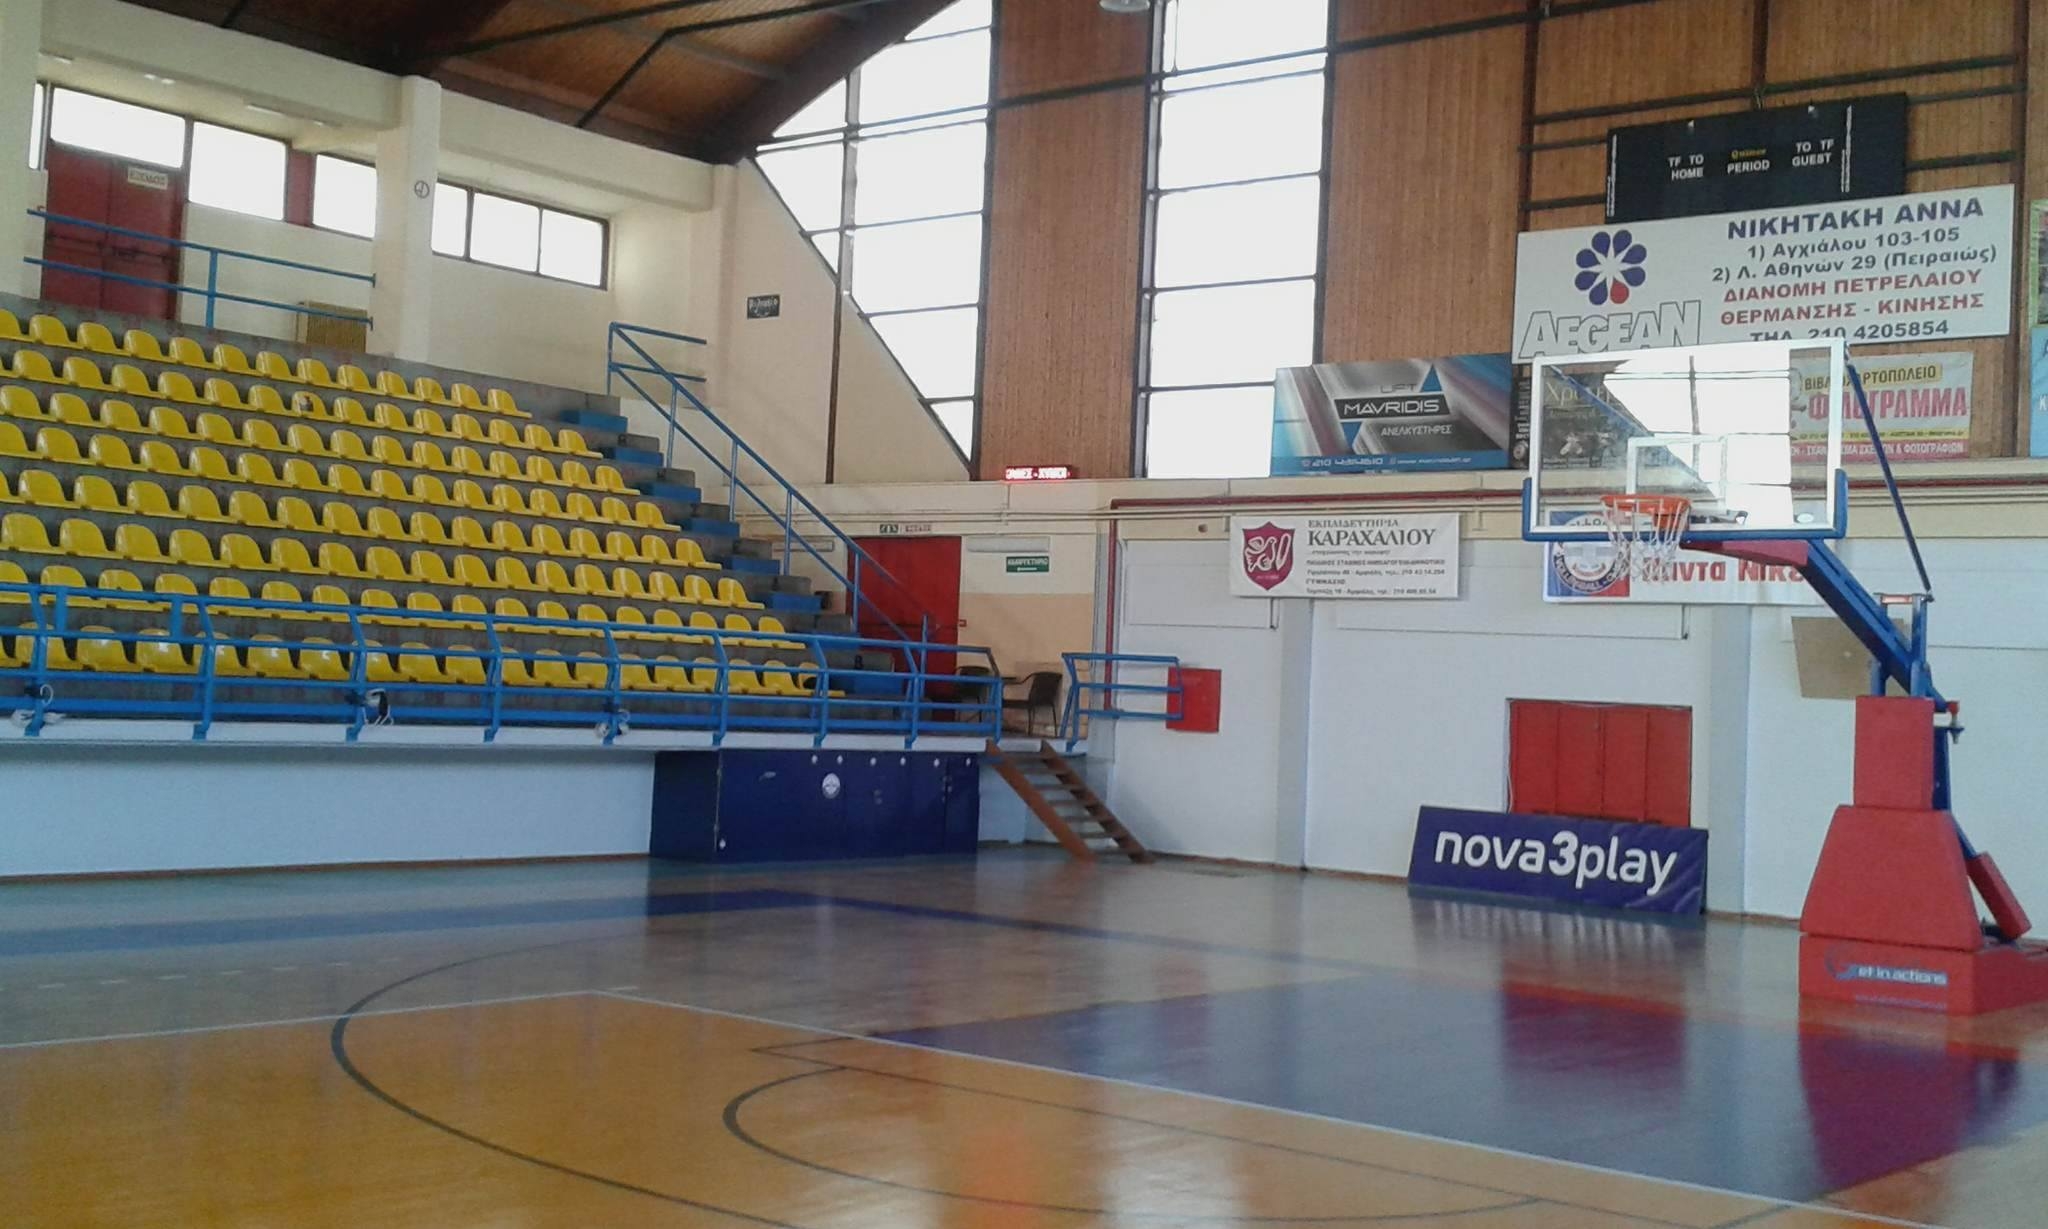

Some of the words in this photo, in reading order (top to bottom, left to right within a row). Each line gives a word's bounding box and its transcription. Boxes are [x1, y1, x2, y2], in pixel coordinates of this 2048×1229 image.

[1796, 142, 1811, 153] TO
[1821, 139, 1834, 150] TF
[1669, 156, 1681, 168] TF
[1689, 154, 1704, 165] TO
[1727, 160, 1770, 174] PERIOD
[1792, 153, 1832, 167] GUEST
[1671, 168, 1704, 180] HOME
[1727, 207, 1883, 240] ΝΙΚΗΤΑΚΗ
[1894, 197, 1984, 224] ΑΝΝΑ
[1747, 244, 1765, 261] 1)
[1772, 237, 1866, 259] Αγχιάλου
[1875, 227, 1960, 246] 103-105
[1712, 266, 1730, 283] 2)
[1737, 265, 1756, 280] Λ.
[1763, 258, 1844, 279] Αθηνών
[1852, 255, 1876, 271] 29
[1884, 243, 1997, 272] (Πειραιώς)
[1724, 281, 1826, 303] ΔΙΑΝΟΜΗ
[1834, 269, 1982, 294] ΠΕΤΡΕΛΑΙΟΥ
[1721, 303, 1856, 325] ΘΕΡΜΑΝΣΗΣ
[1878, 293, 1984, 315] ΚΙΝΗΣΗΣ
[1518, 300, 1701, 359] AEGEAN
[1808, 325, 1846, 339] 210
[1854, 320, 1948, 340] 4205854
[1343, 399, 1440, 416] MAVRIDIS
[1808, 387, 1968, 420] ΦΛΓΡΑΜΜΑ
[1308, 519, 1399, 528] ΕΚΠΑΙΔΕΥΤΗΡΙΑ
[1308, 529, 1436, 546] ΚΑΡΑΧΑΛΙΟΥ
[1434, 830, 1678, 897] nova3play
